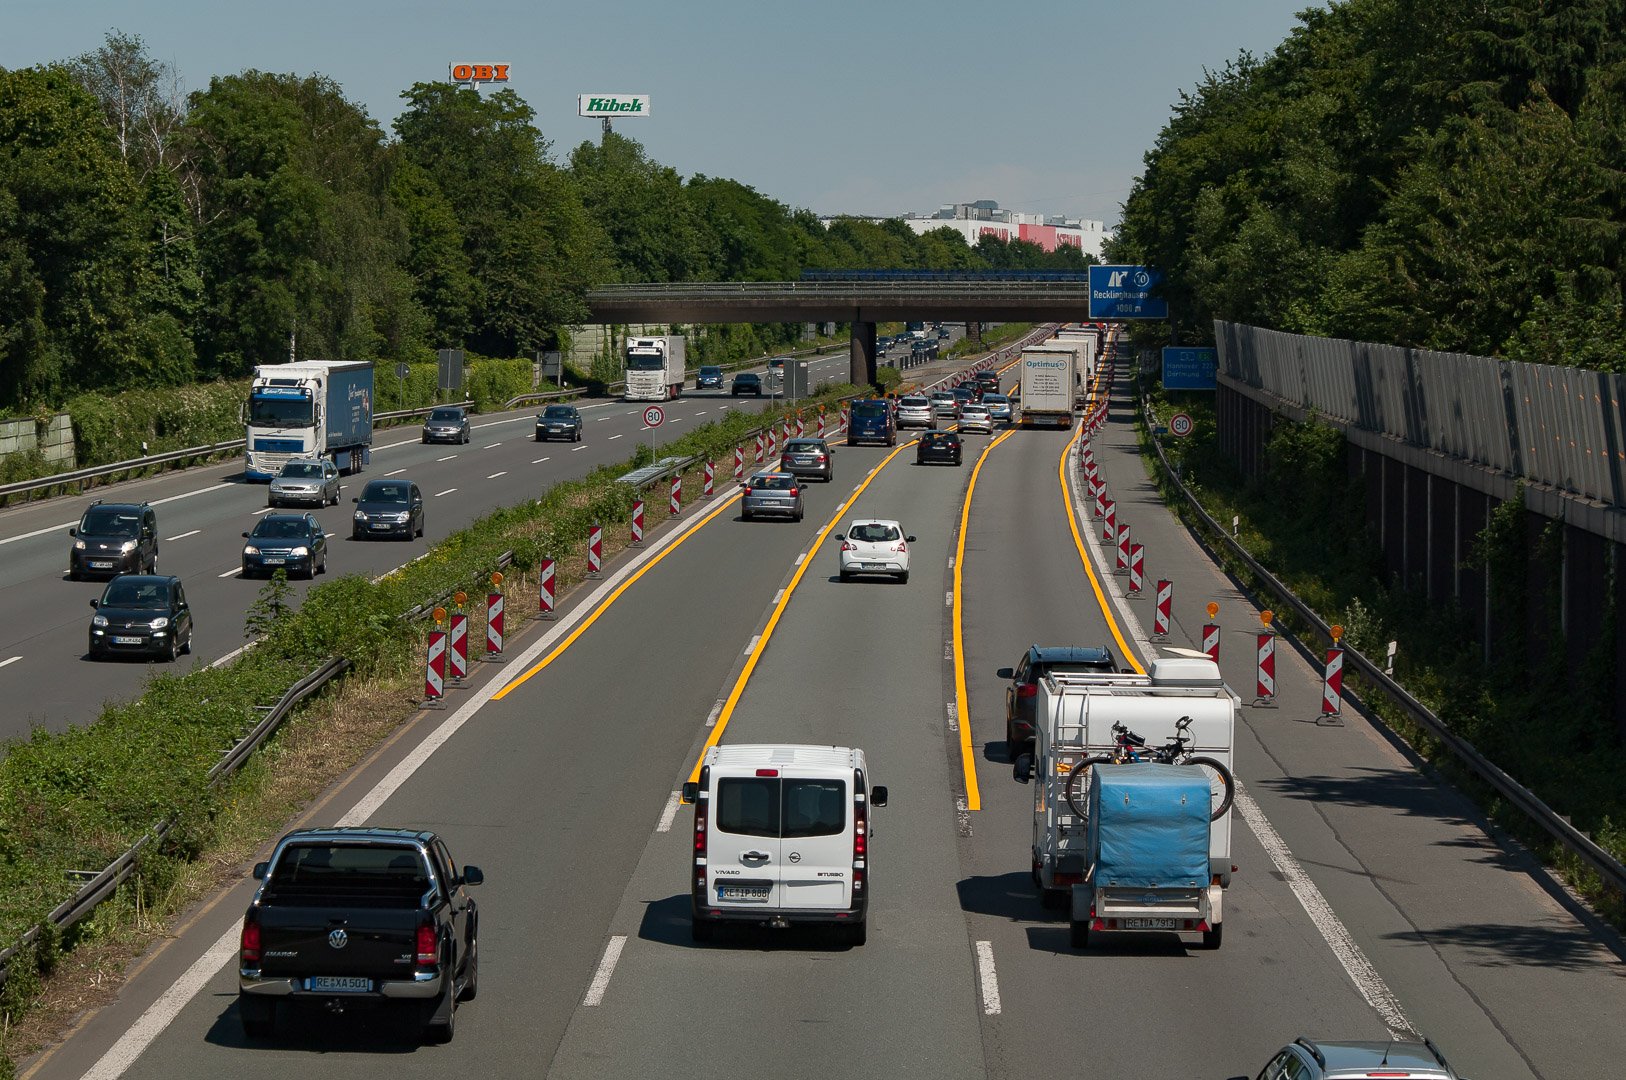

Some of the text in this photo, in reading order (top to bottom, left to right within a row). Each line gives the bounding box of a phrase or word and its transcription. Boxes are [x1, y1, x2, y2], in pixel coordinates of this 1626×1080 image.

[453, 65, 509, 80] OBI
[586, 98, 644, 112] Kibek
[1137, 275, 1146, 283] 10
[1093, 290, 1148, 300] Recklinghausen
[1116, 304, 1132, 312] 1000
[1026, 360, 1059, 368] Optimus
[648, 411, 660, 422] 80
[1175, 420, 1188, 430] 80
[724, 888, 735, 897] RE
[752, 889, 767, 897] 888
[1128, 919, 1140, 927] RE
[1155, 919, 1174, 927] 7913
[317, 977, 367, 988] RE XA 501
